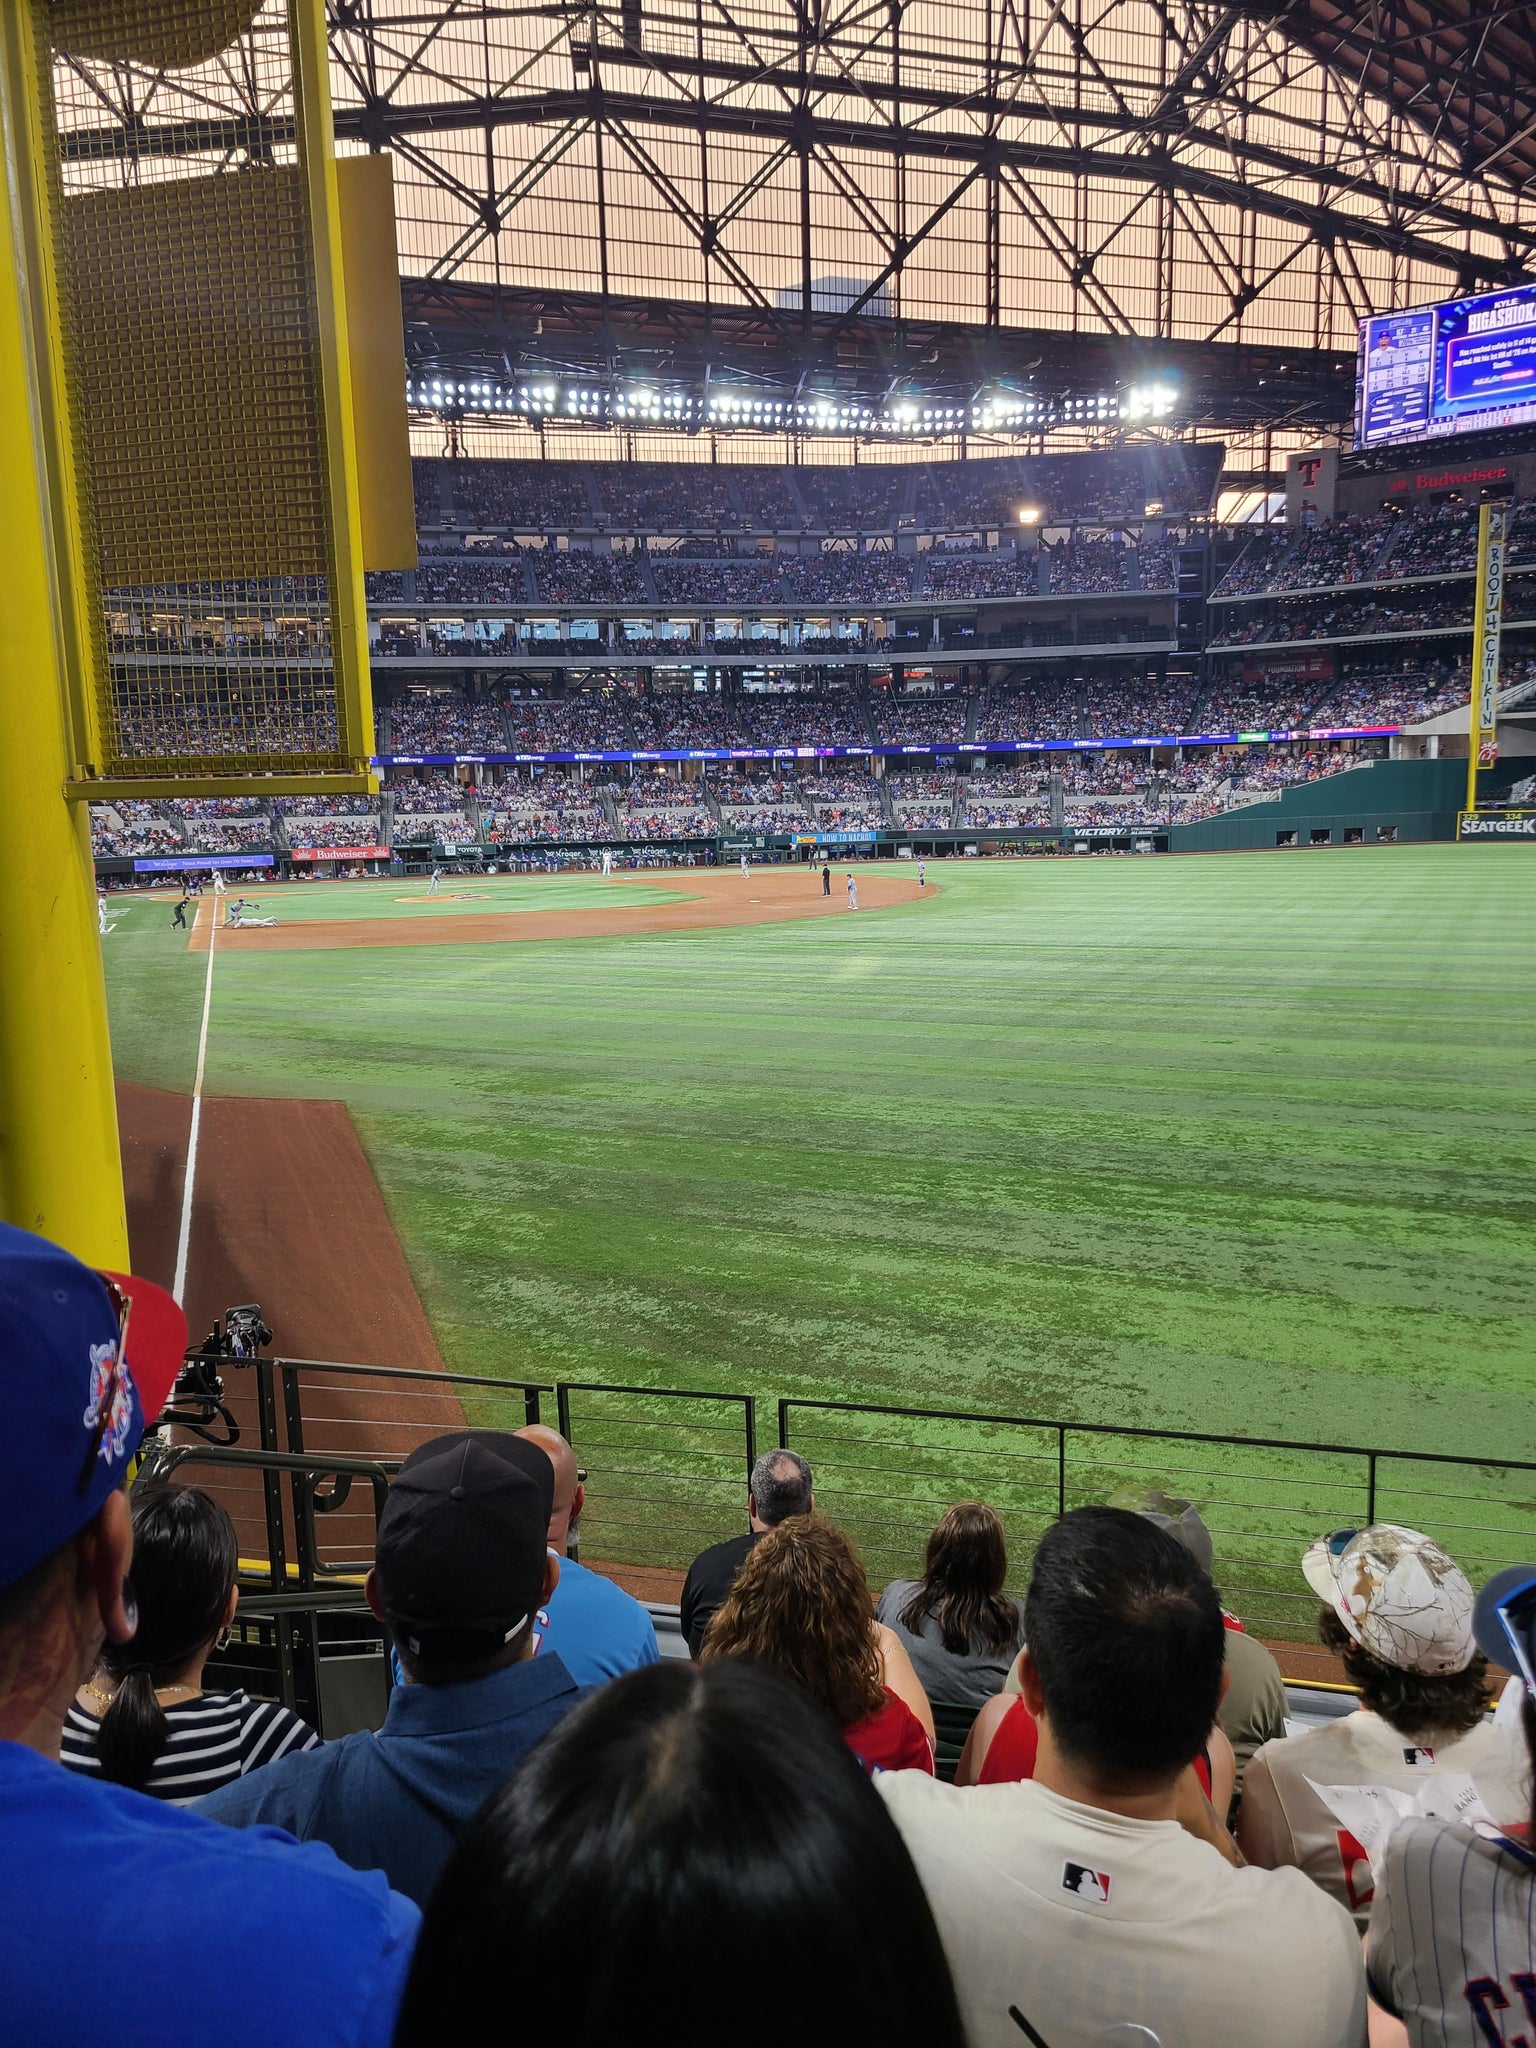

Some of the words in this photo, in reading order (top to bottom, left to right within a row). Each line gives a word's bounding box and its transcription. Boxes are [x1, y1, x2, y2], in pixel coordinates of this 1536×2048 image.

[1494, 298, 1520, 309] KYLE
[1268, 663, 1306, 673] FOUNDATION
[1461, 819, 1536, 834] SEATGEEK
[1074, 827, 1122, 836] VICTORY
[822, 834, 837, 842] HOW
[839, 833, 847, 842] TO
[317, 850, 367, 859] Budweiser
[556, 848, 582, 857] Kroger
[641, 845, 667, 856] Kroger
